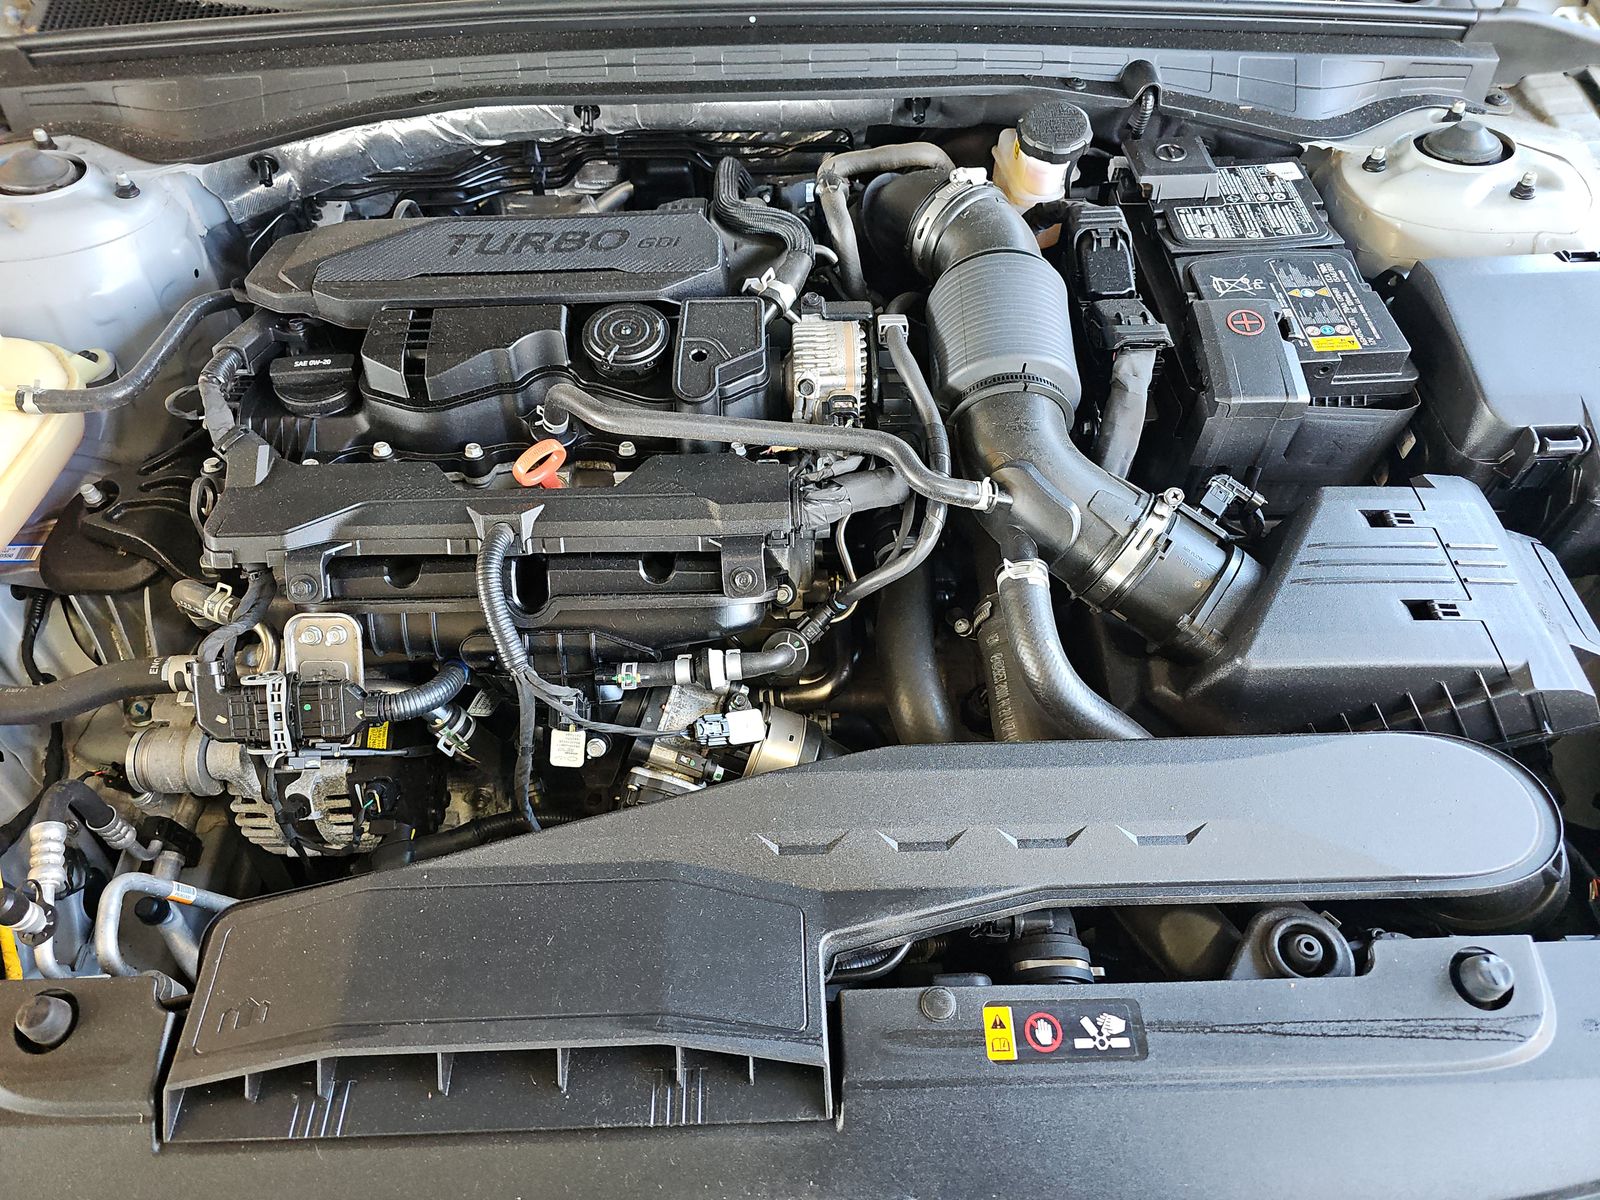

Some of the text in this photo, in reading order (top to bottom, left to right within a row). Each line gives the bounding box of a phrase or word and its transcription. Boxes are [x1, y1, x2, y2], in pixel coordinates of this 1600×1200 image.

[448, 229, 681, 258] TURBO GDI
[1253, 278, 1267, 290] Pb
[293, 358, 332, 368] SAE 0W-20
